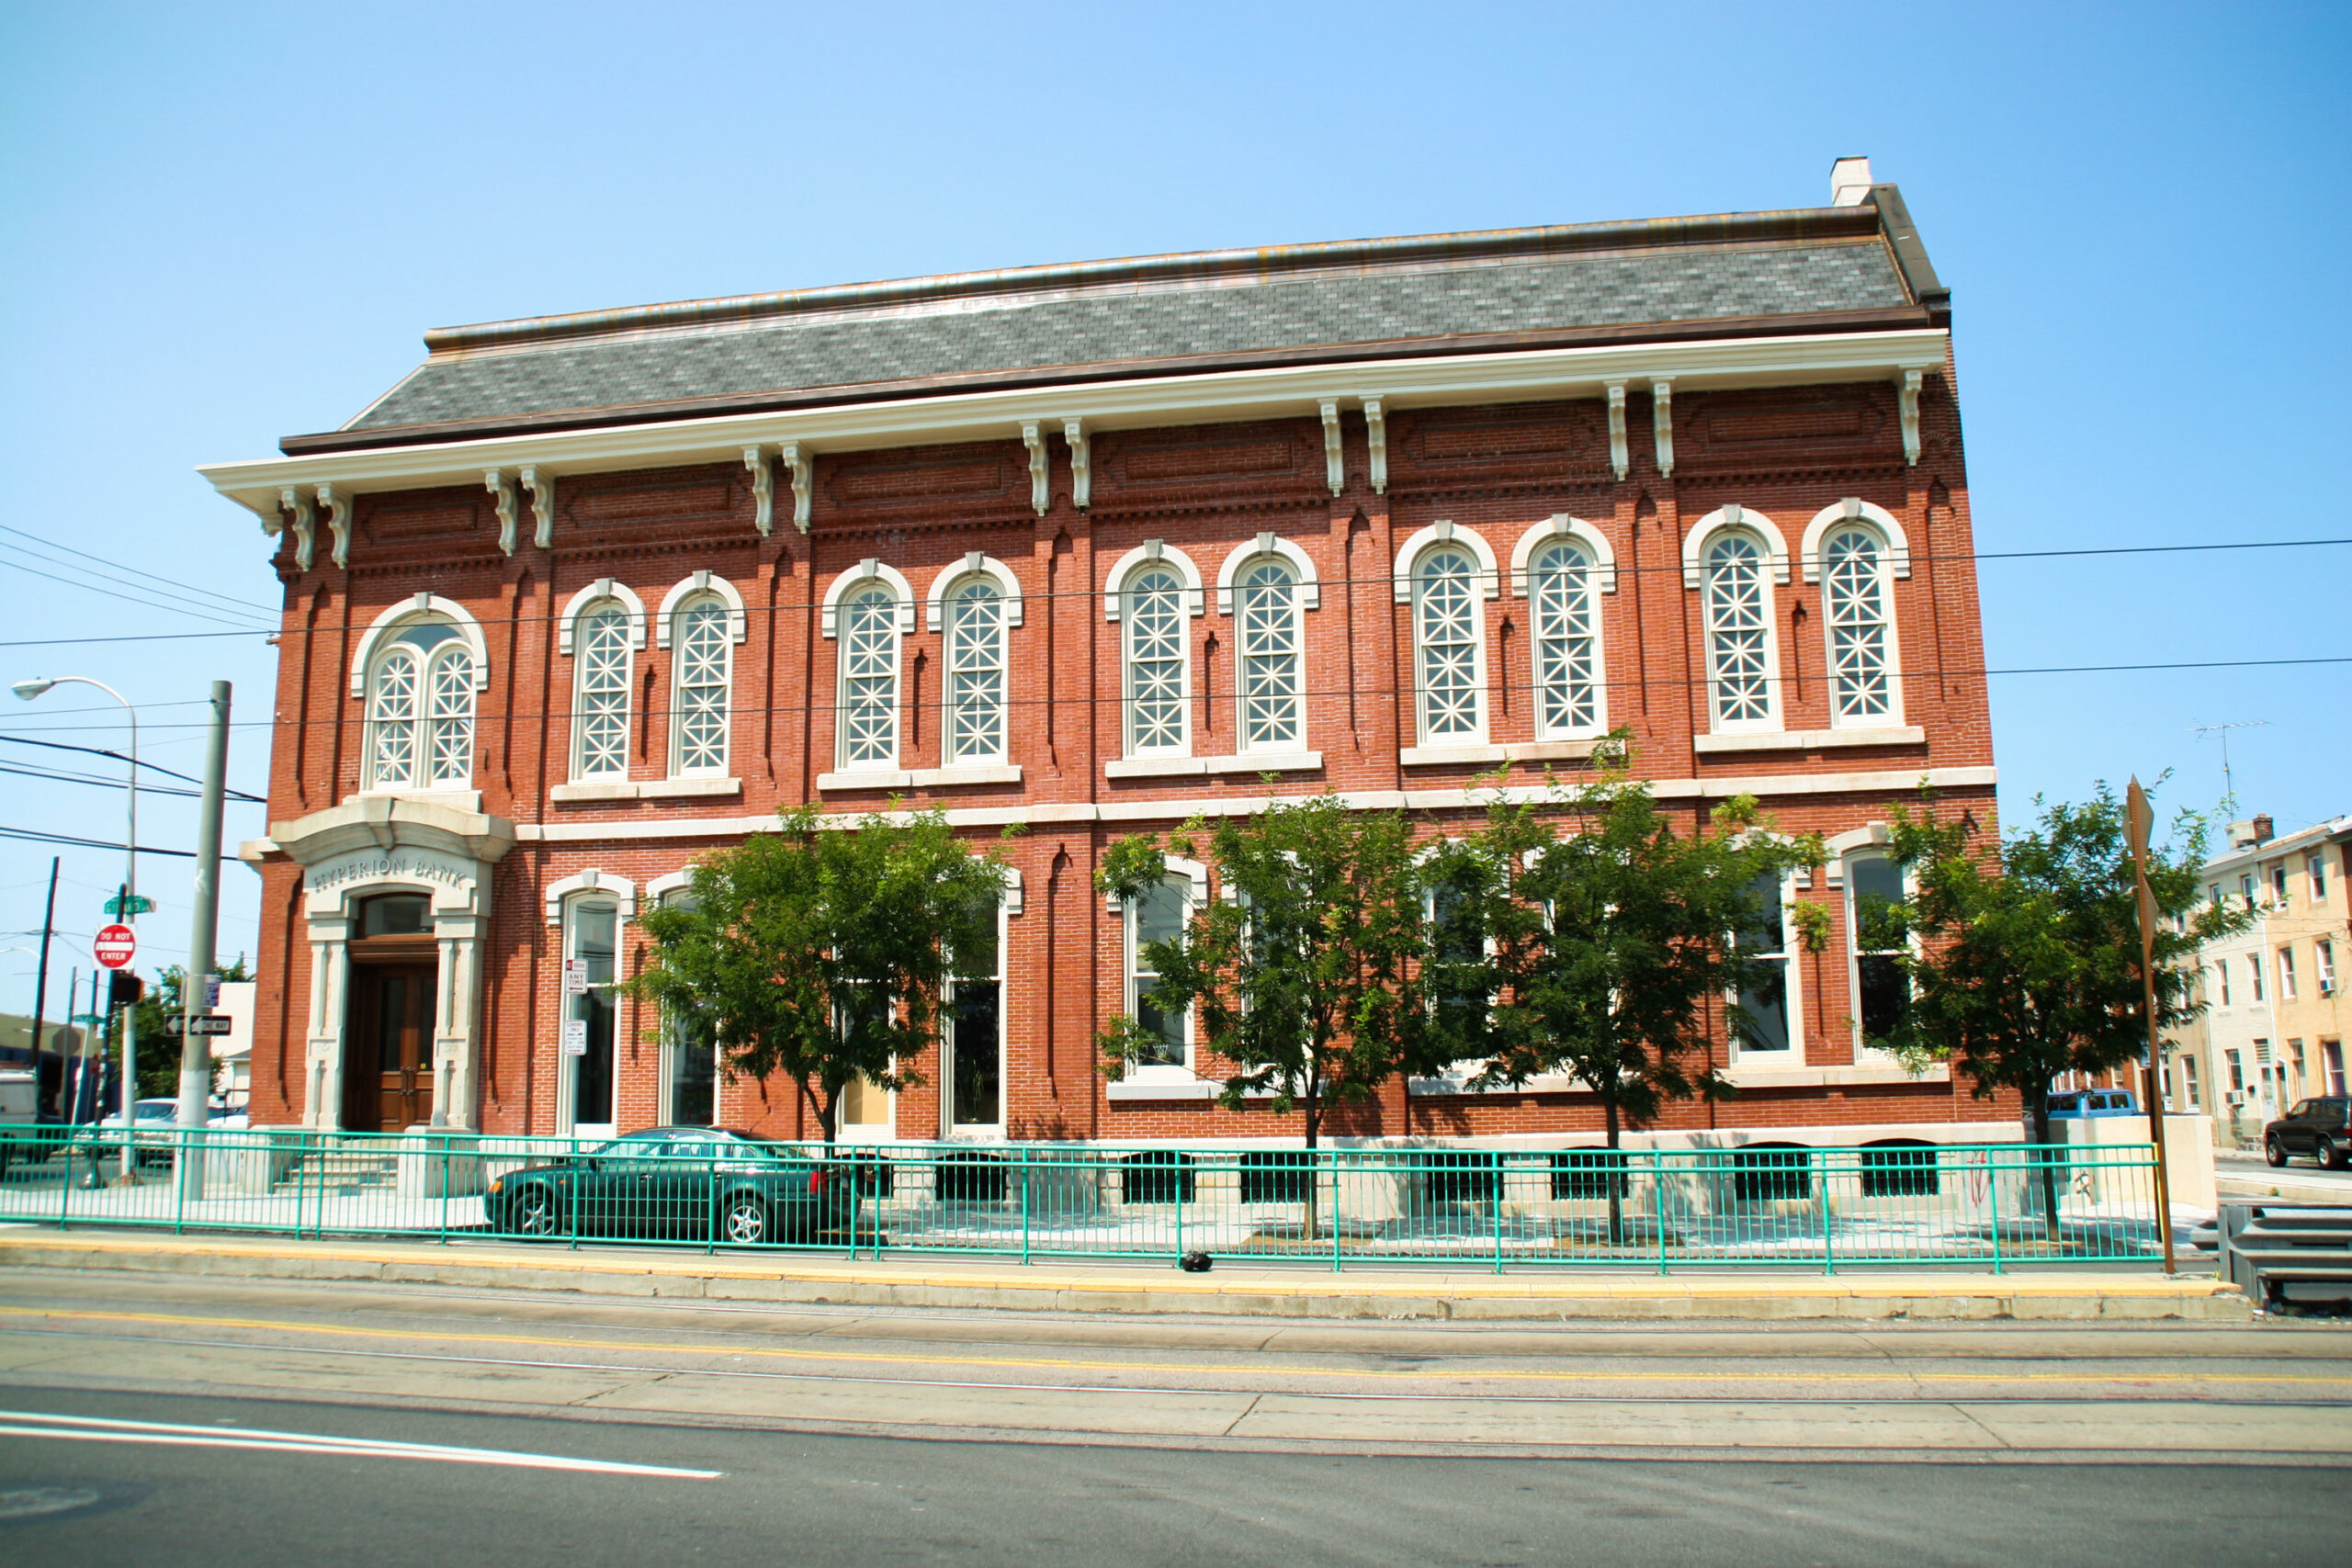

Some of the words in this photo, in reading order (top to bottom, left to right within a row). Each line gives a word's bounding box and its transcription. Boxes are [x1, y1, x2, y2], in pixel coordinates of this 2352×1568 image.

[314, 859, 407, 893] HYPERION
[414, 861, 466, 891] BANK
[100, 932, 112, 941] DO
[115, 932, 130, 941] NOT
[101, 952, 126, 960] ENTER
[216, 1021, 227, 1030] WAY
